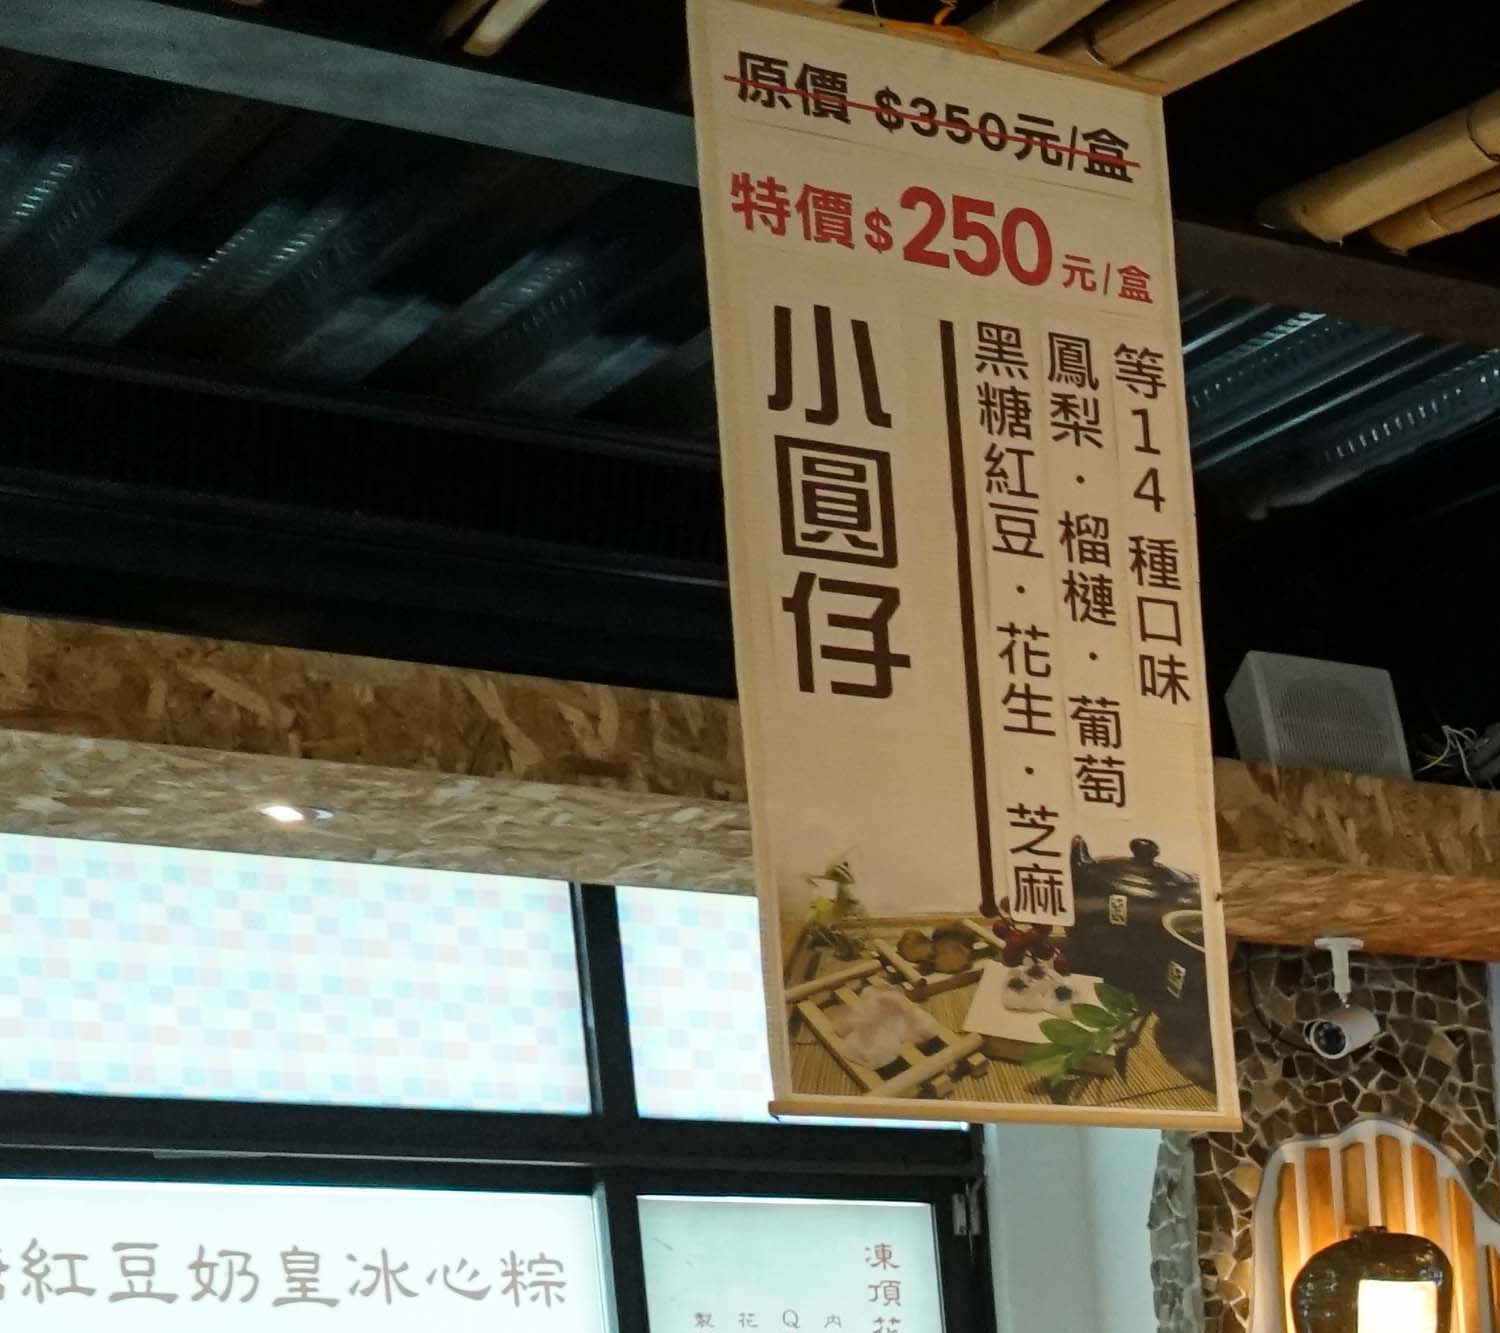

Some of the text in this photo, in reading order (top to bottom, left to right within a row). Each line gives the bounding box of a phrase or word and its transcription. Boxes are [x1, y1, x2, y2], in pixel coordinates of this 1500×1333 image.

[737, 51, 1136, 184] 原價 $350元/盒
[767, 304, 911, 699] 小圓仔
